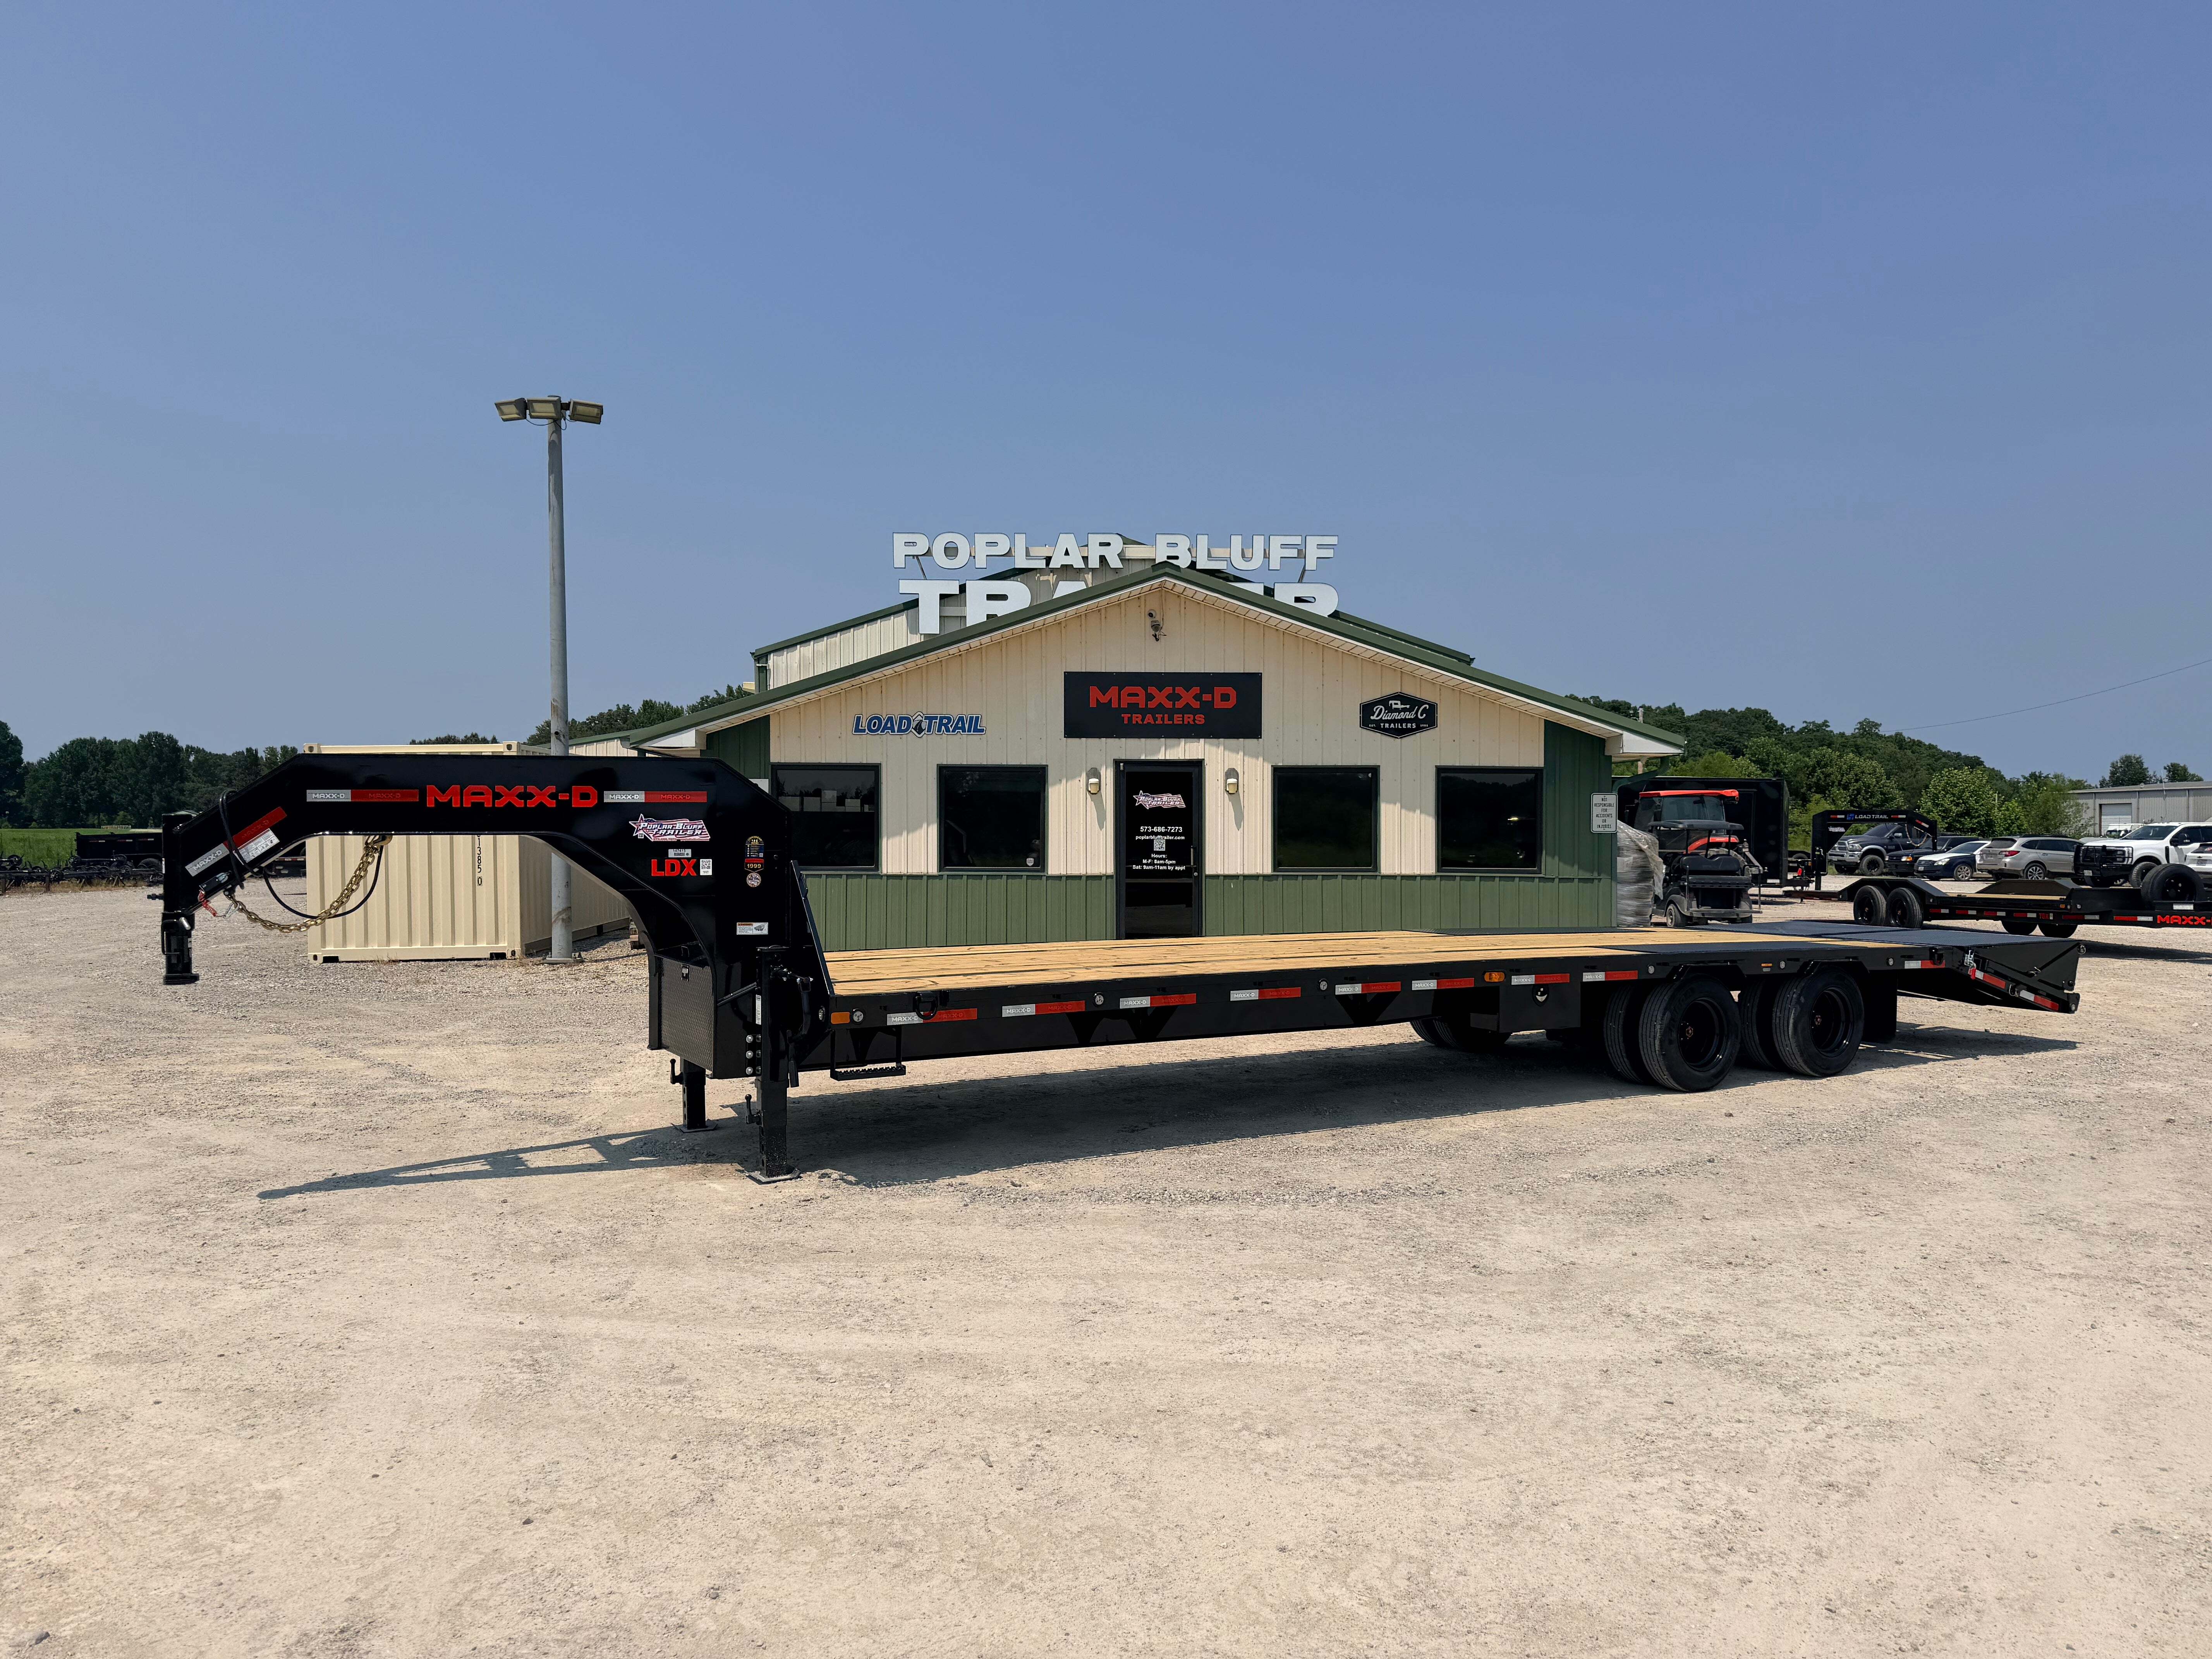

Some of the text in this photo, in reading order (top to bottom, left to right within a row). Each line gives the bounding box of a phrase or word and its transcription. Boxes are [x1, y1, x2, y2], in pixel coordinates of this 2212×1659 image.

[892, 532, 1339, 570] POPLAR BLUFF
[1089, 686, 1237, 708] MAXX-D
[1121, 714, 1205, 724] TRAILERS
[1370, 704, 1429, 720] Diamond C
[853, 714, 986, 735] LOAD TRAIL
[427, 785, 598, 807] MAXX-D
[651, 859, 697, 876] LDX
[2157, 915, 2212, 926] MAXX-
